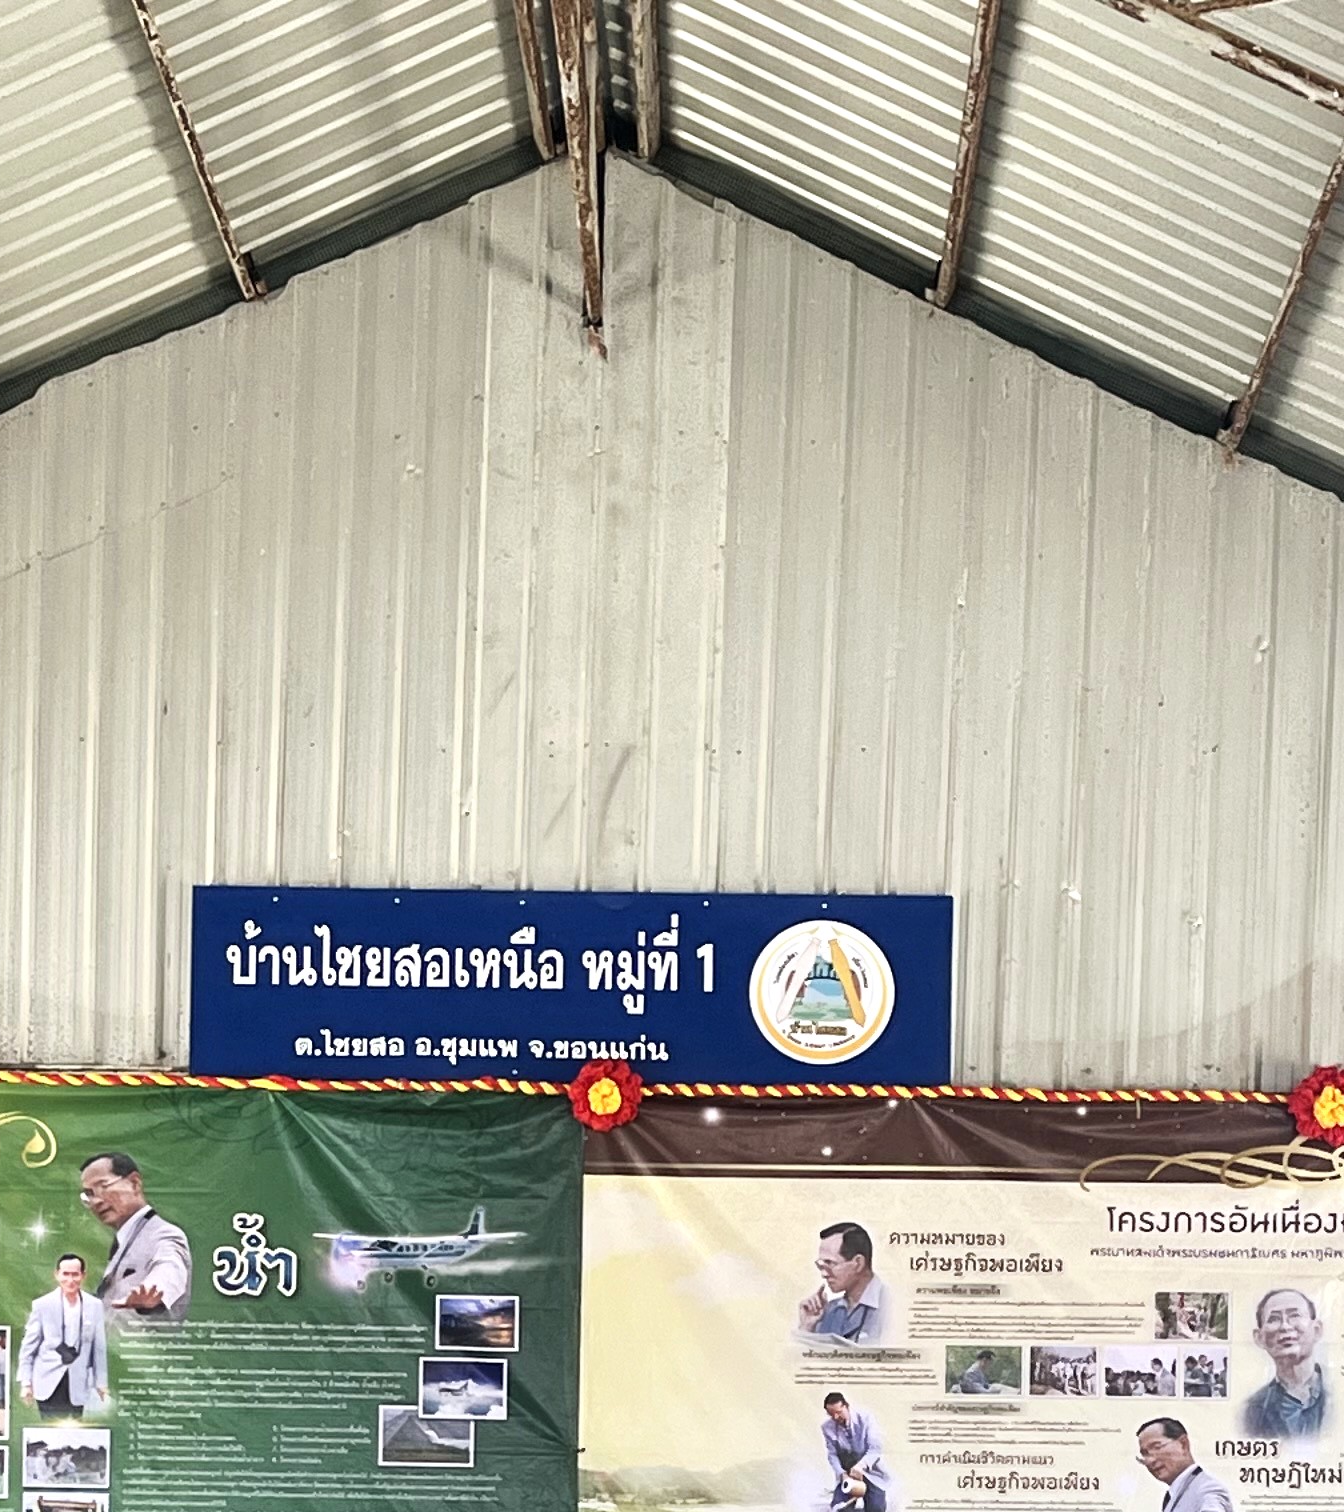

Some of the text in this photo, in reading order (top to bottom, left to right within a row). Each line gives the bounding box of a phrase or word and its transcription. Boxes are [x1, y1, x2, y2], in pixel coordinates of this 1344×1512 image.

[226, 919, 564, 990] บ้านไชยสอเหนือ
[581, 913, 680, 1015] หมู่ที่
[695, 943, 716, 993] 1
[294, 1029, 669, 1065] ต.ไชยสอ อ.ชุมแพ จ.ขอนแก่น
[889, 1231, 1006, 1247] ความหมายของ
[213, 1212, 298, 1297] น้ำ
[909, 1251, 1064, 1277] เศรษฐกิจพอเพียง
[1215, 1438, 1280, 1457] เกษตร
[957, 1469, 1100, 1494] เศรษฐกิจพอเพียง
[1239, 1461, 1343, 1489] ทฤษฎีใหม่
